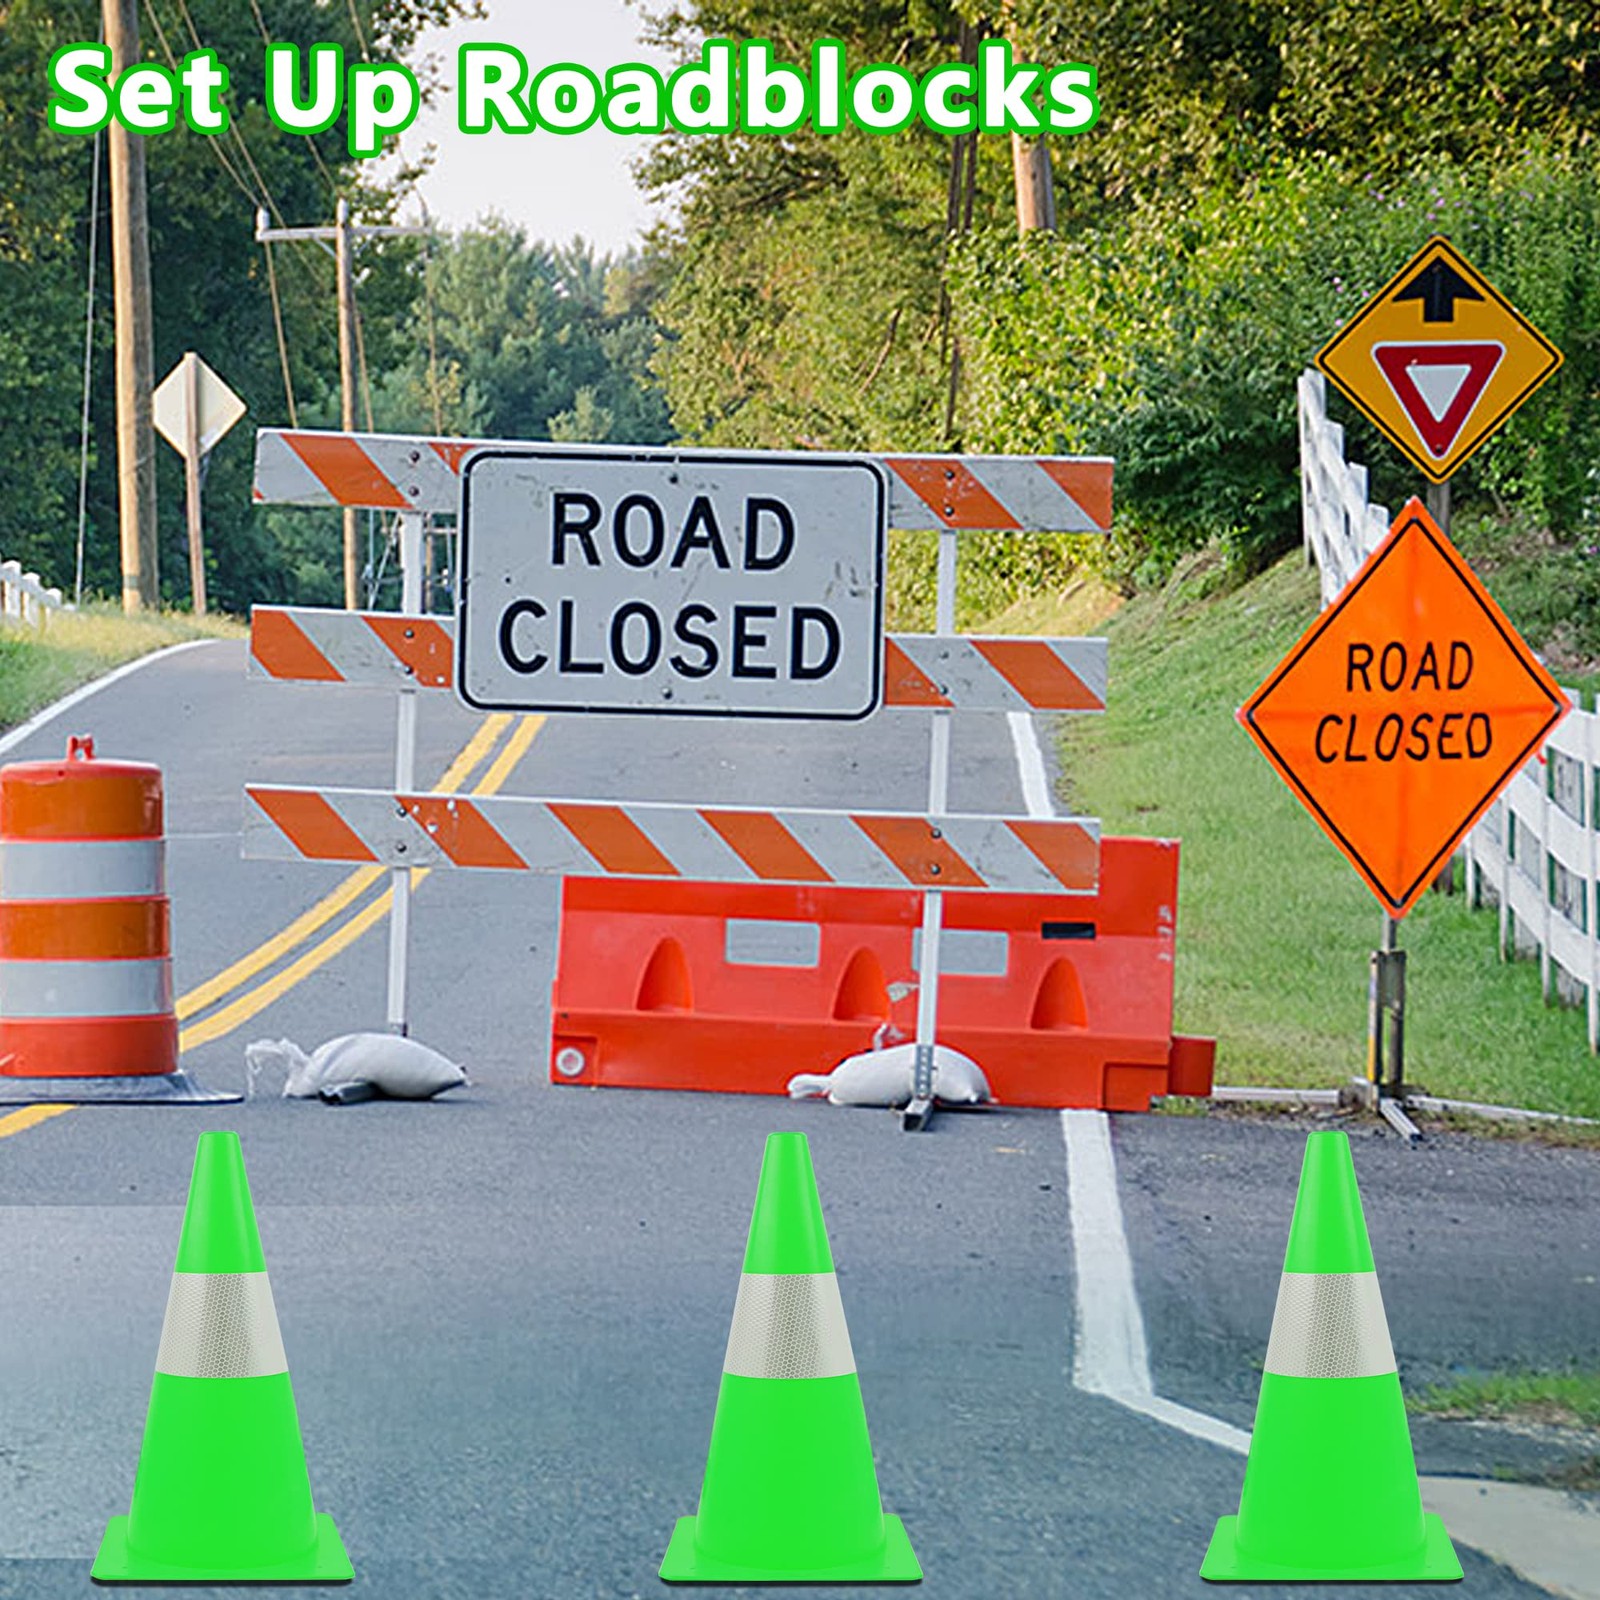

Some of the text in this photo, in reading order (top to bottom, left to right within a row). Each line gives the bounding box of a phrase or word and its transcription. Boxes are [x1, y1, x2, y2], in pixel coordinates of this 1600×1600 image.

[552, 492, 795, 571] ROAD
[499, 599, 841, 680] CLOSED
[1347, 641, 1473, 692] ROAD
[1315, 712, 1493, 764] CLOSED
